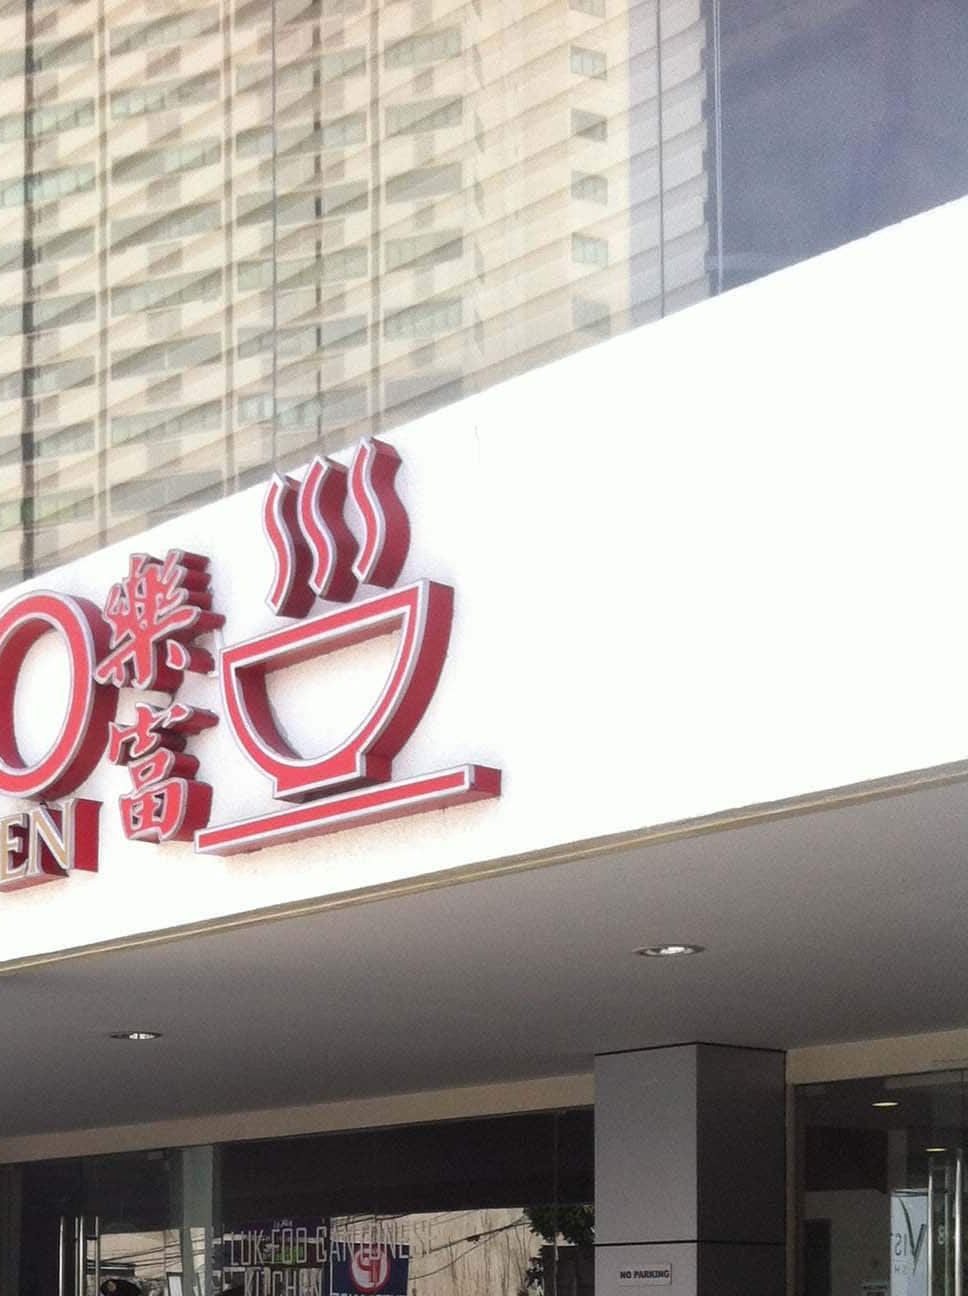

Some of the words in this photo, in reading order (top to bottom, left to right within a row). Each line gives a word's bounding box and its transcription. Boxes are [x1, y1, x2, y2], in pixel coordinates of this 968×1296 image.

[231, 1230, 265, 1267] LUK
[271, 1227, 309, 1264] FOO
[620, 1270, 632, 1279] NO
[633, 1269, 670, 1279] PARKING
